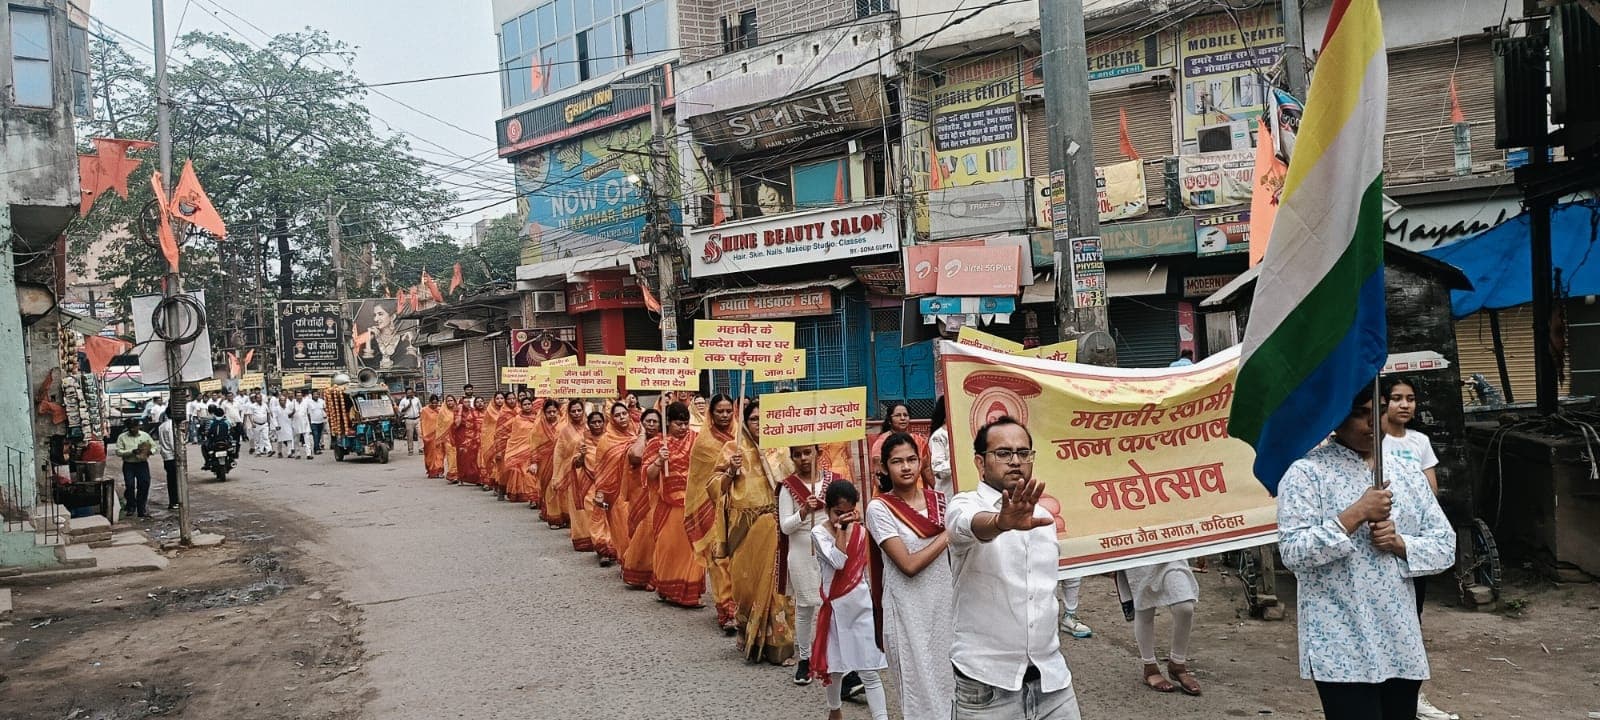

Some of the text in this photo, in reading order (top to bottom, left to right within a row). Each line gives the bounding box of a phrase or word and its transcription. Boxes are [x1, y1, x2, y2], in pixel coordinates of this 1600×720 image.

[1188, 26, 1284, 51] MOBILE CENTR
[975, 80, 1014, 101] CENTRE
[729, 92, 852, 136] SHINE
[551, 183, 598, 217] NOW
[701, 211, 883, 265] SHINE BEAUTY SALON
[1384, 208, 1507, 248] Mayan
[717, 323, 772, 334] महावीर के
[699, 337, 790, 349] सन्देश को घर घर
[636, 354, 667, 364] महावीर
[682, 355, 689, 364] ये
[704, 352, 783, 367] तक पहुँचाना है
[629, 366, 655, 375] सन्देश
[657, 367, 675, 376] नशा
[640, 378, 650, 387] हो
[672, 379, 686, 387] देश
[766, 405, 801, 420] महावीर
[803, 407, 817, 417] का
[819, 403, 828, 415] ये
[1070, 383, 1235, 430] महावीर स्वामी
[763, 416, 862, 436] देखो अपना अपना दोष
[1051, 437, 1115, 460] जन्म
[1085, 459, 1228, 511] महोत्सव
[1098, 532, 1134, 549] सकल
[1135, 526, 1158, 543] जैन
